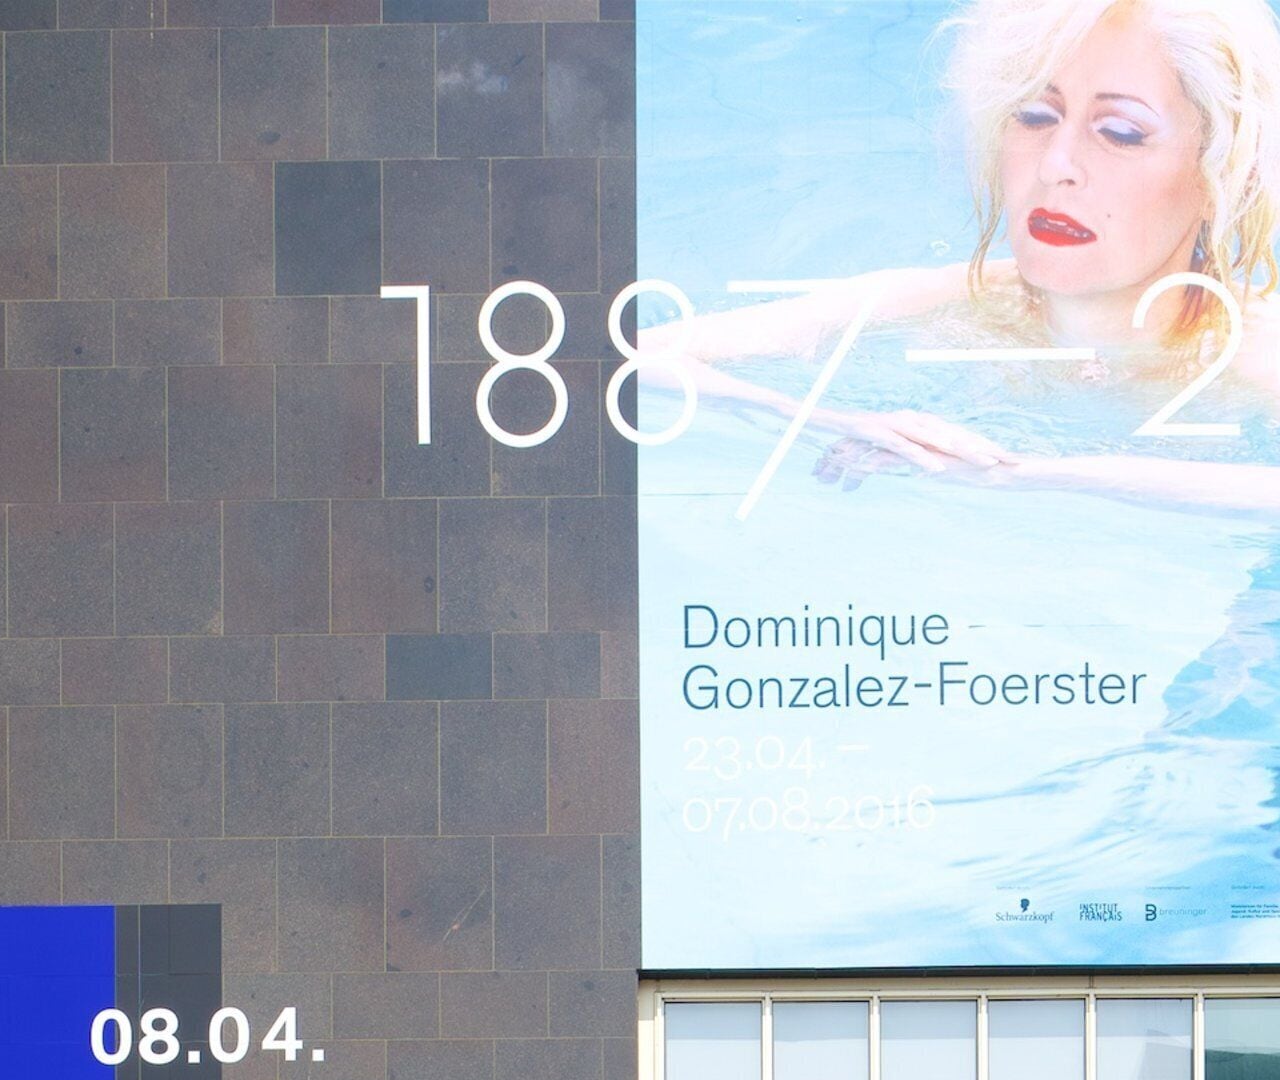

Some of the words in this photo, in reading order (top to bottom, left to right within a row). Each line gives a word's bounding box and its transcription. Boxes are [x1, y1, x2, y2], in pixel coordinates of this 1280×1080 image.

[683, 603, 950, 661] Dominique
[682, 661, 1148, 711] Gonzalez-Foerster
[682, 734, 827, 780] 23.04.
[682, 783, 936, 842] 07.08.2016
[995, 910, 1055, 922] Schwarzkopf
[1079, 903, 1118, 912] INSTITUT
[91, 1006, 325, 1065] 08.04.
